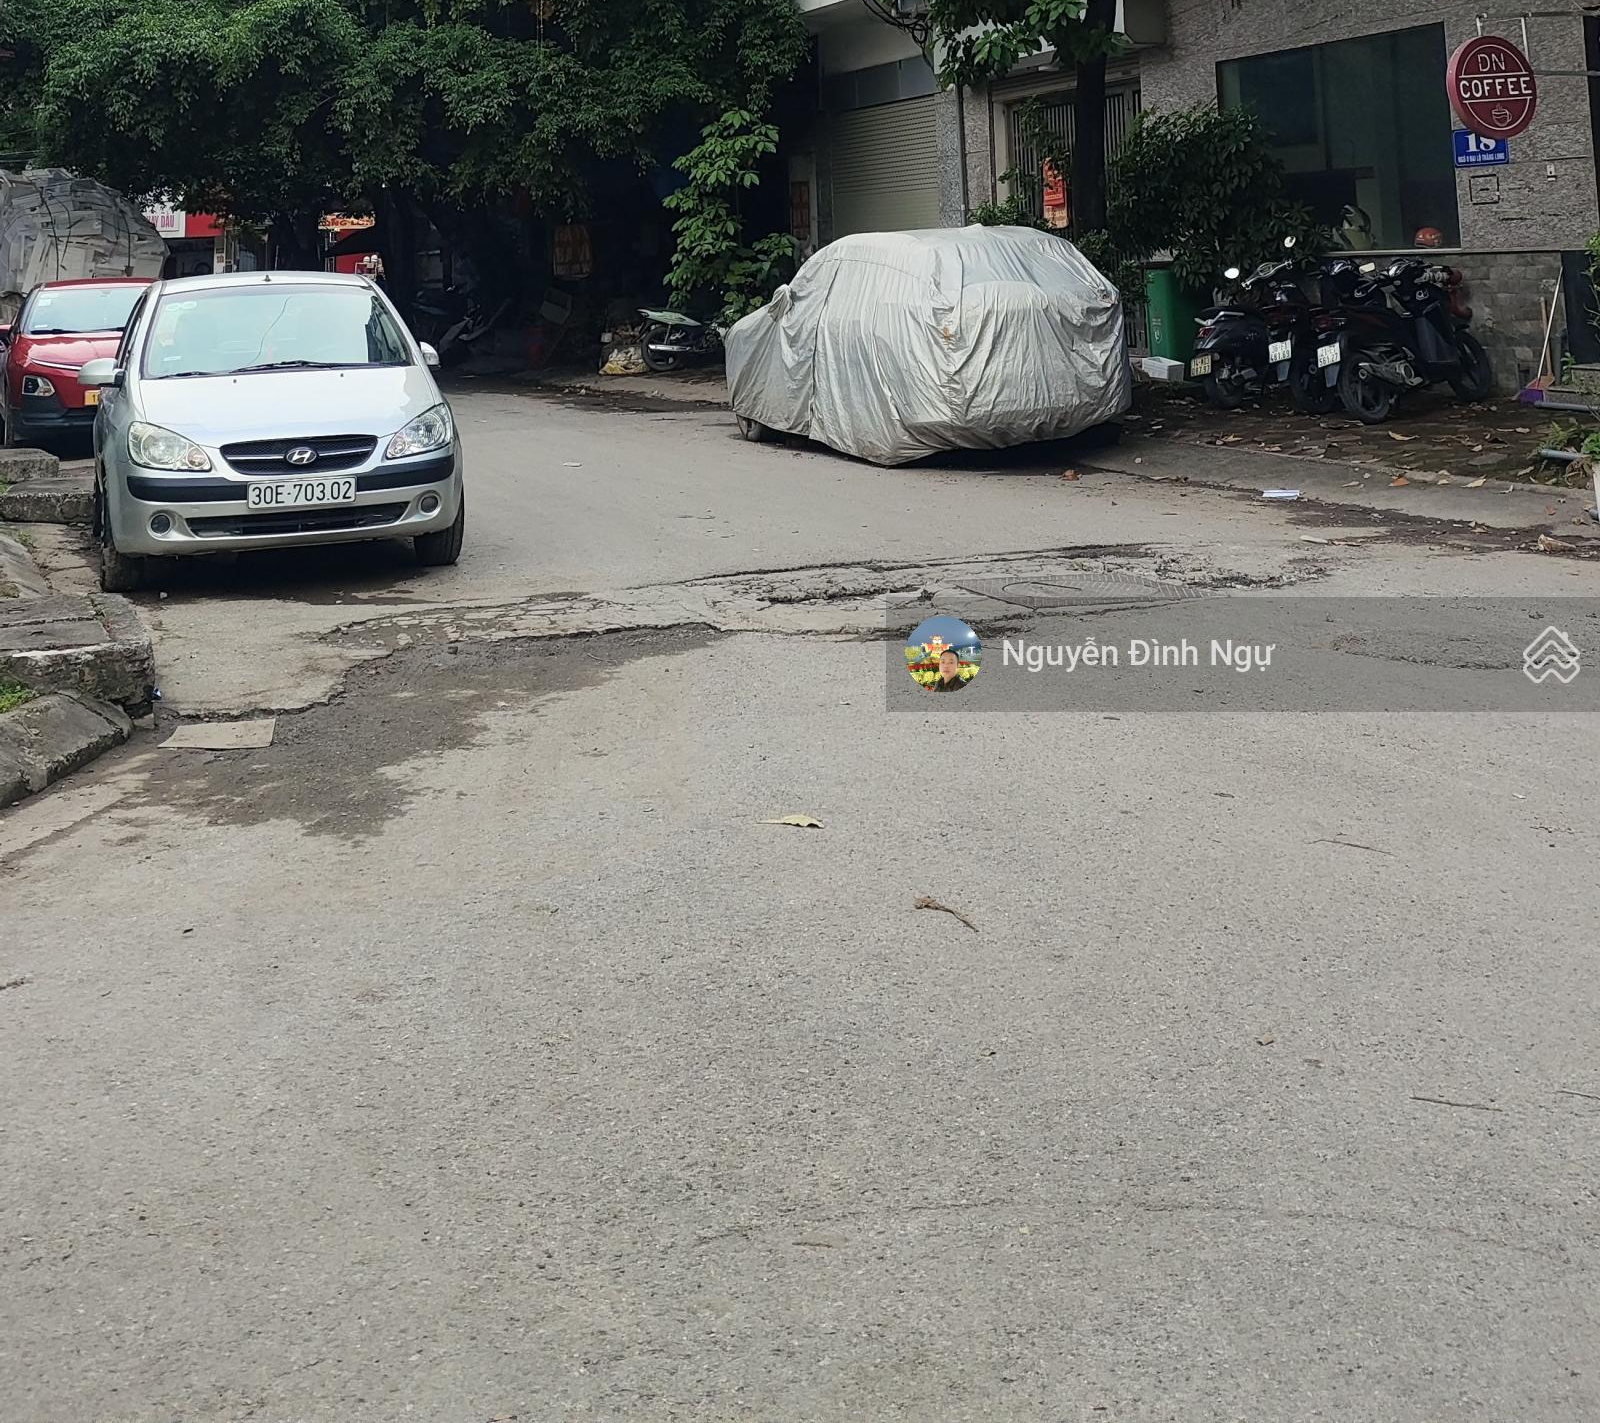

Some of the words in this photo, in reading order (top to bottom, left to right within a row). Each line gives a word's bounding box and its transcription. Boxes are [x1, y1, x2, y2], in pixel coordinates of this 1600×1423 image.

[1477, 53, 1506, 72] DN
[1460, 77, 1532, 98] COFFEE
[252, 481, 352, 505] 30E-703.02
